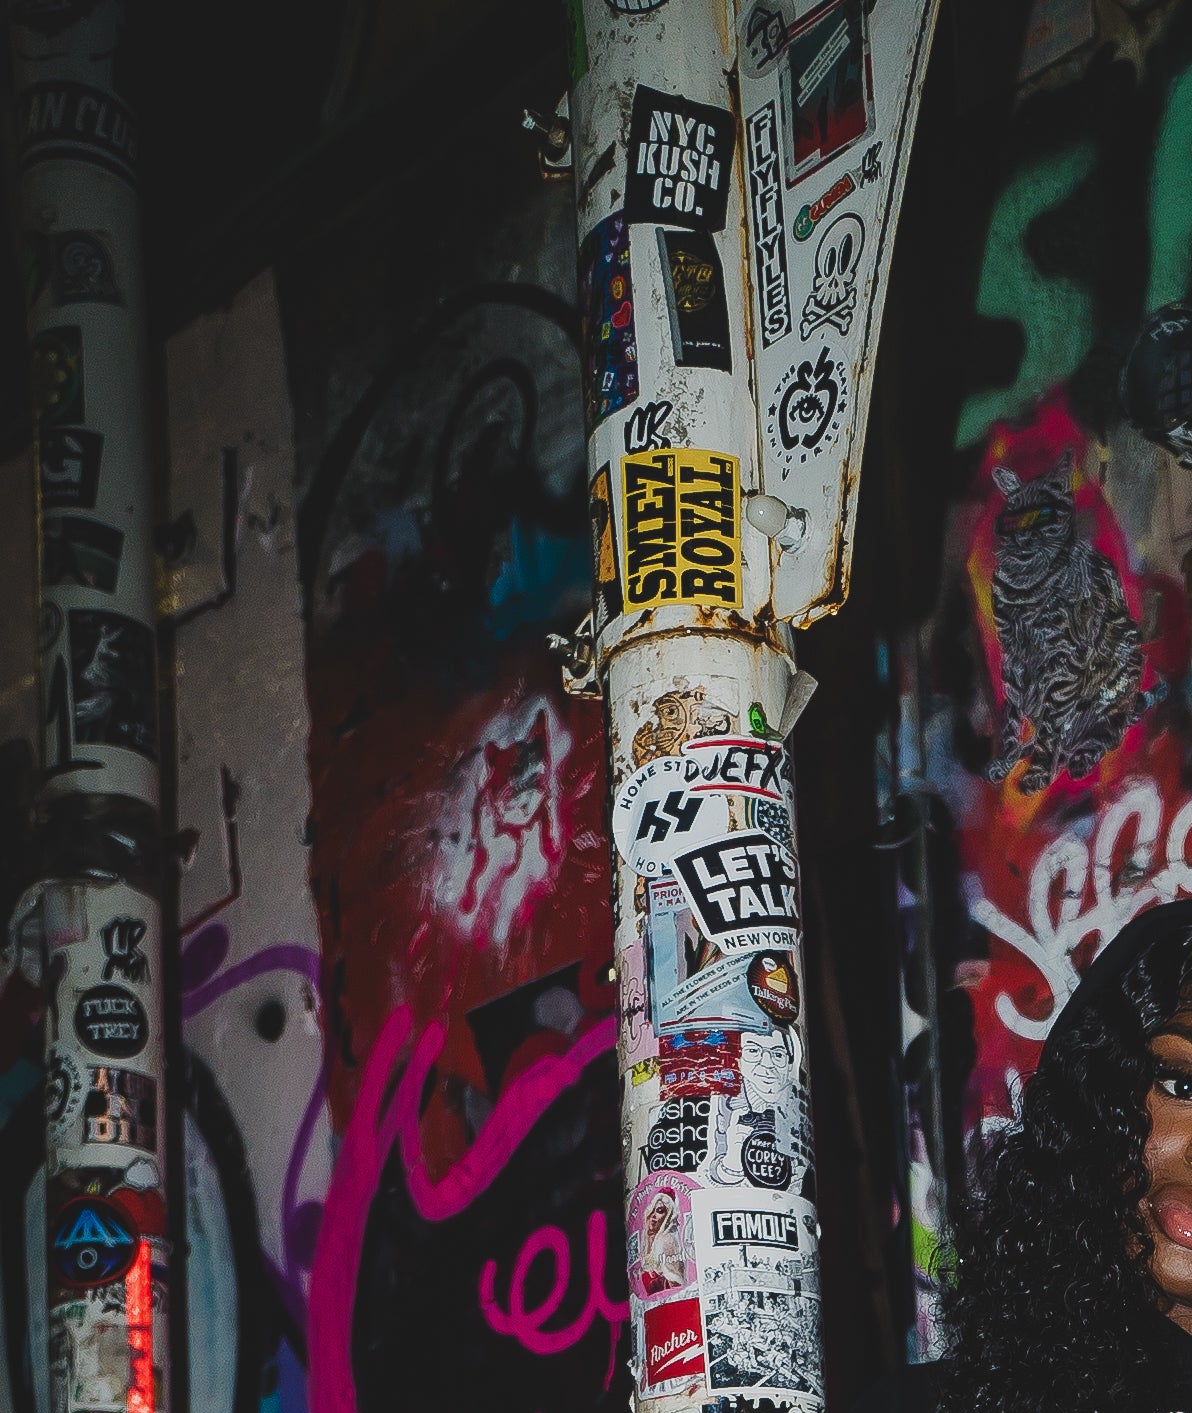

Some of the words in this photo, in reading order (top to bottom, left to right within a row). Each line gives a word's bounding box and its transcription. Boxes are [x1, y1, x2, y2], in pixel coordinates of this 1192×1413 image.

[649, 108, 717, 156] NYC
[637, 143, 721, 190] KUSH
[652, 178, 704, 217] CO.
[750, 106, 789, 344] FLYFLYLES
[627, 453, 678, 606] SMEZ
[680, 455, 739, 605] ROYAL
[620, 765, 658, 810] HOME
[692, 843, 797, 889] LET'S
[706, 883, 800, 924] TALK
[724, 931, 760, 950] NEW
[761, 930, 797, 947] YORK
[685, 968, 717, 991] FLOWERS
[752, 1164, 783, 1181] LEE?
